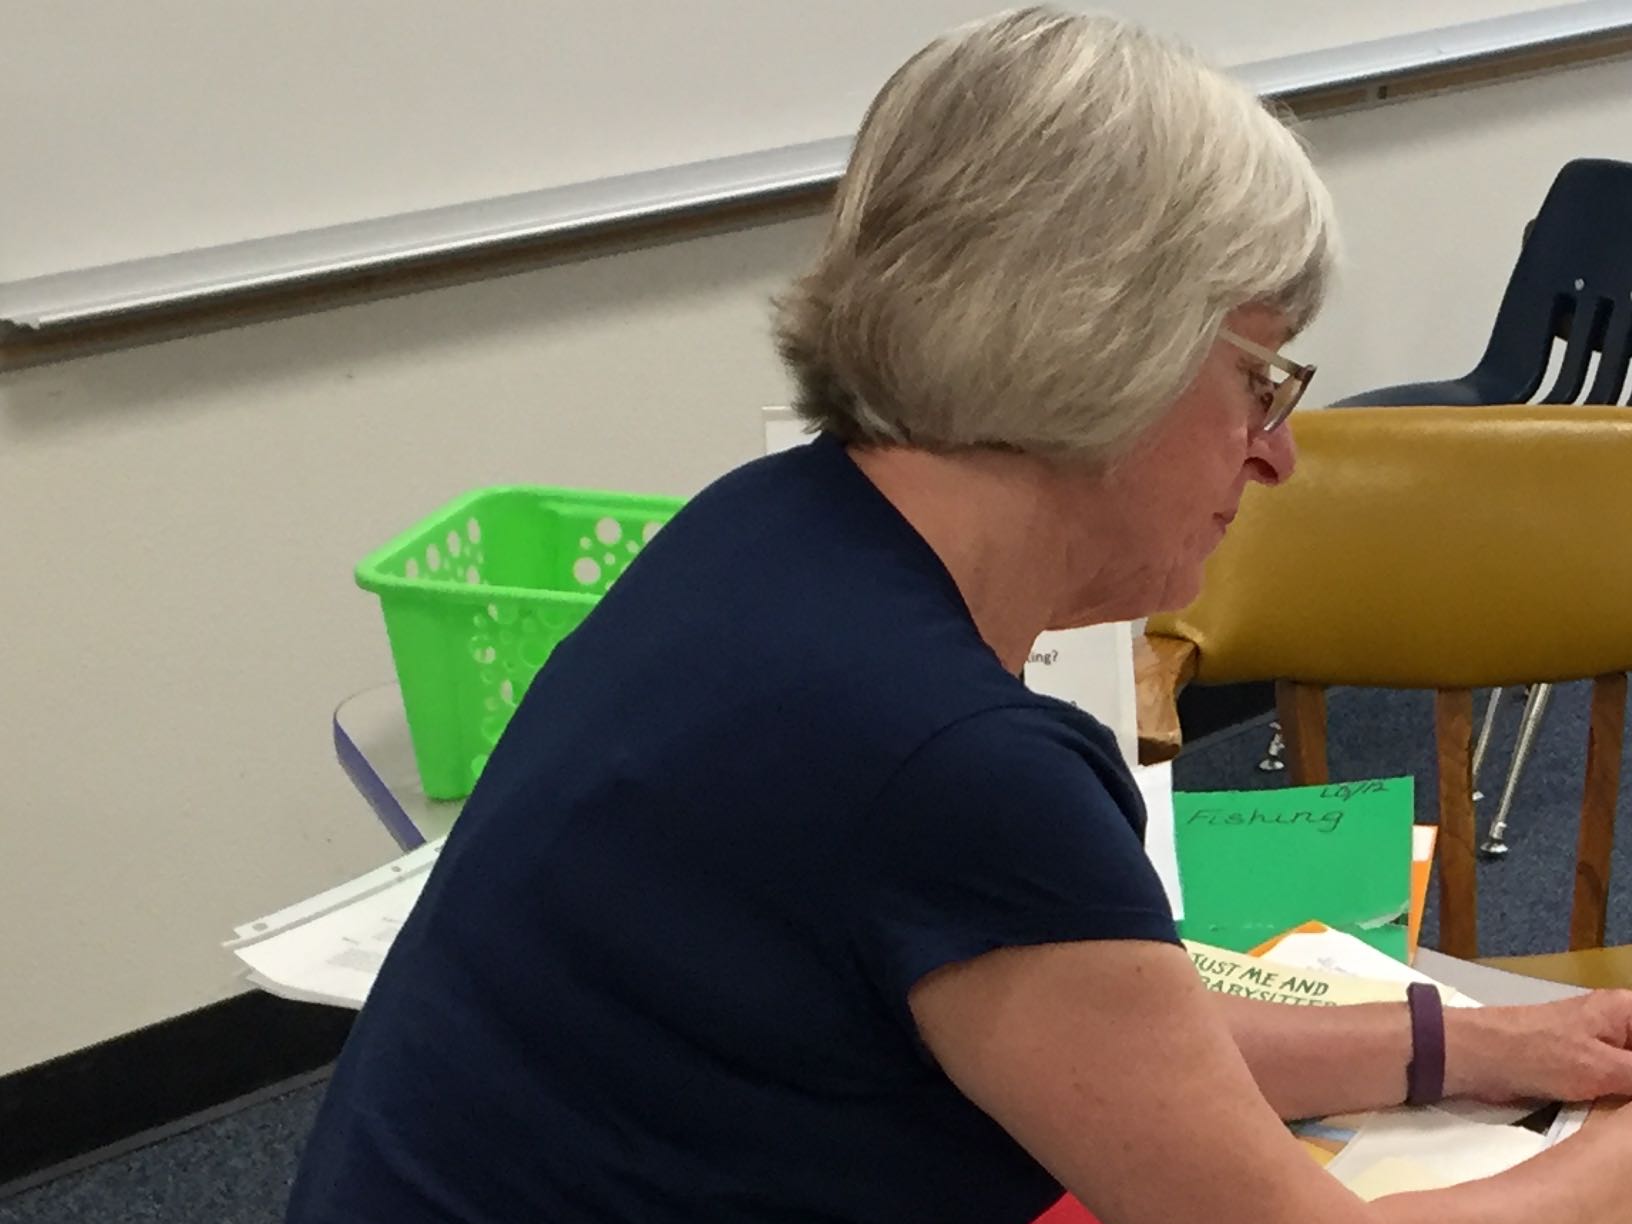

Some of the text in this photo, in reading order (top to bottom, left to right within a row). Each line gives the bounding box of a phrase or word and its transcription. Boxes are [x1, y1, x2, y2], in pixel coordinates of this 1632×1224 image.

[1028, 649, 1058, 665] ing?
[1187, 808, 1344, 832] Fishing
[1191, 952, 1330, 997] JUST ME AND
[1199, 976, 1337, 1006] BABYSITT
